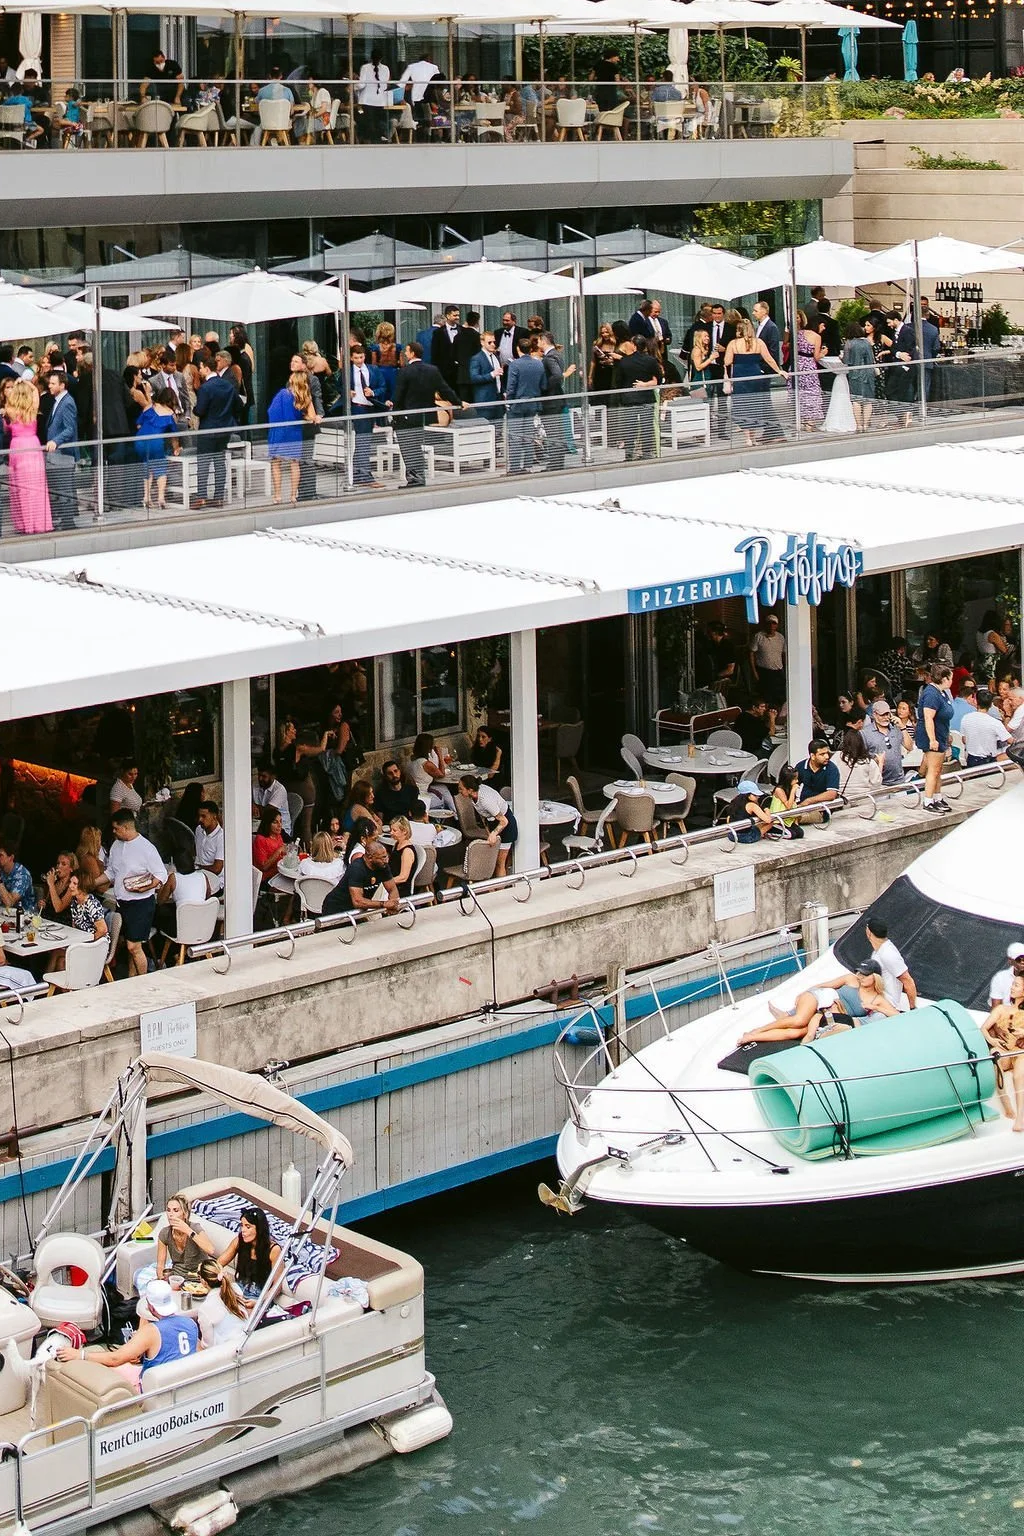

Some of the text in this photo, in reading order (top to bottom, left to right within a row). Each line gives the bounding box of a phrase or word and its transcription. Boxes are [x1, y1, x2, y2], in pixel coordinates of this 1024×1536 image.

[641, 532, 863, 624] PIZZERIA Portofino
[173, 1039, 188, 1047] ONLY
[178, 1331, 190, 1355] 6
[100, 1401, 224, 1456] RentChicagoBoats.com
